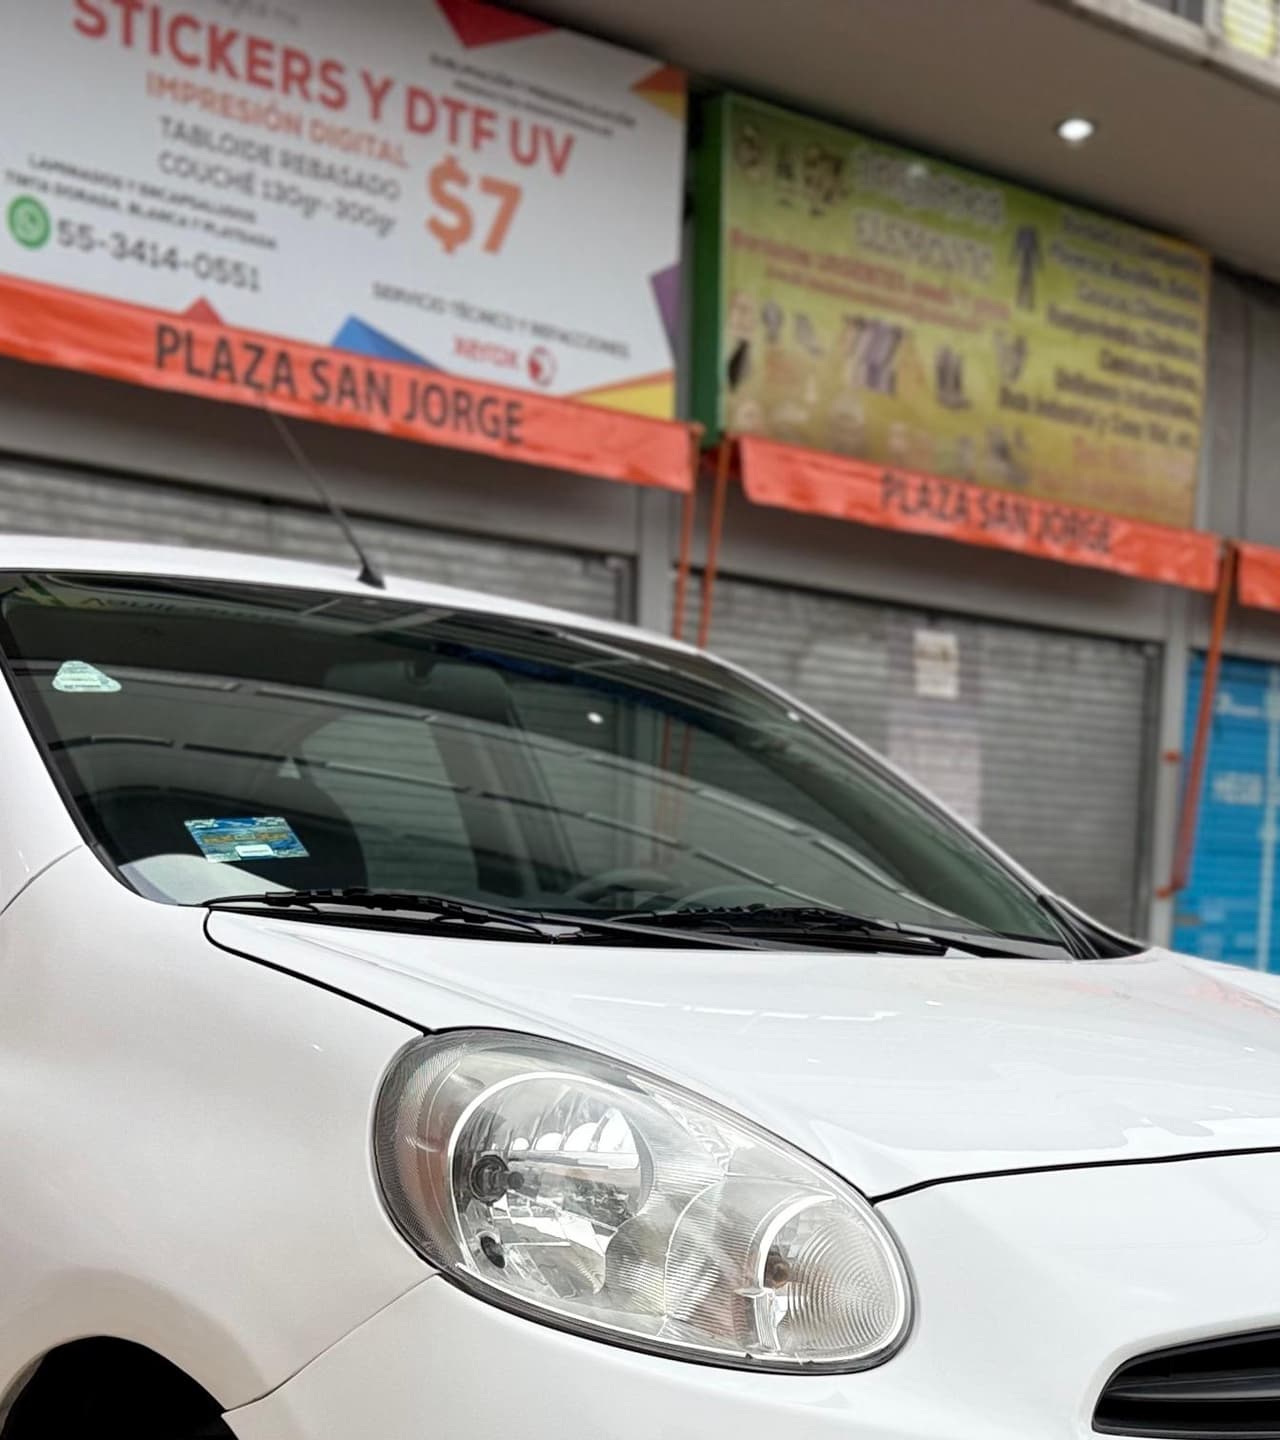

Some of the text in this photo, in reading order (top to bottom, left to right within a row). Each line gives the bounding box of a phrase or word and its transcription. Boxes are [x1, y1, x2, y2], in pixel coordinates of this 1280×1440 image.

[72, 0, 347, 111] STICKERS
[360, 69, 394, 122] Y
[405, 86, 500, 151] DTF
[509, 118, 576, 177] UV
[146, 71, 410, 170] IMPRESIÓN DIGITAL
[160, 115, 272, 167] TABLOIDE
[426, 155, 523, 255] $7
[56, 218, 260, 292] 55-3414-0551
[155, 322, 523, 444] PLAZA SAN JORGE
[881, 471, 1111, 555] PLAZA SAN JORGE
